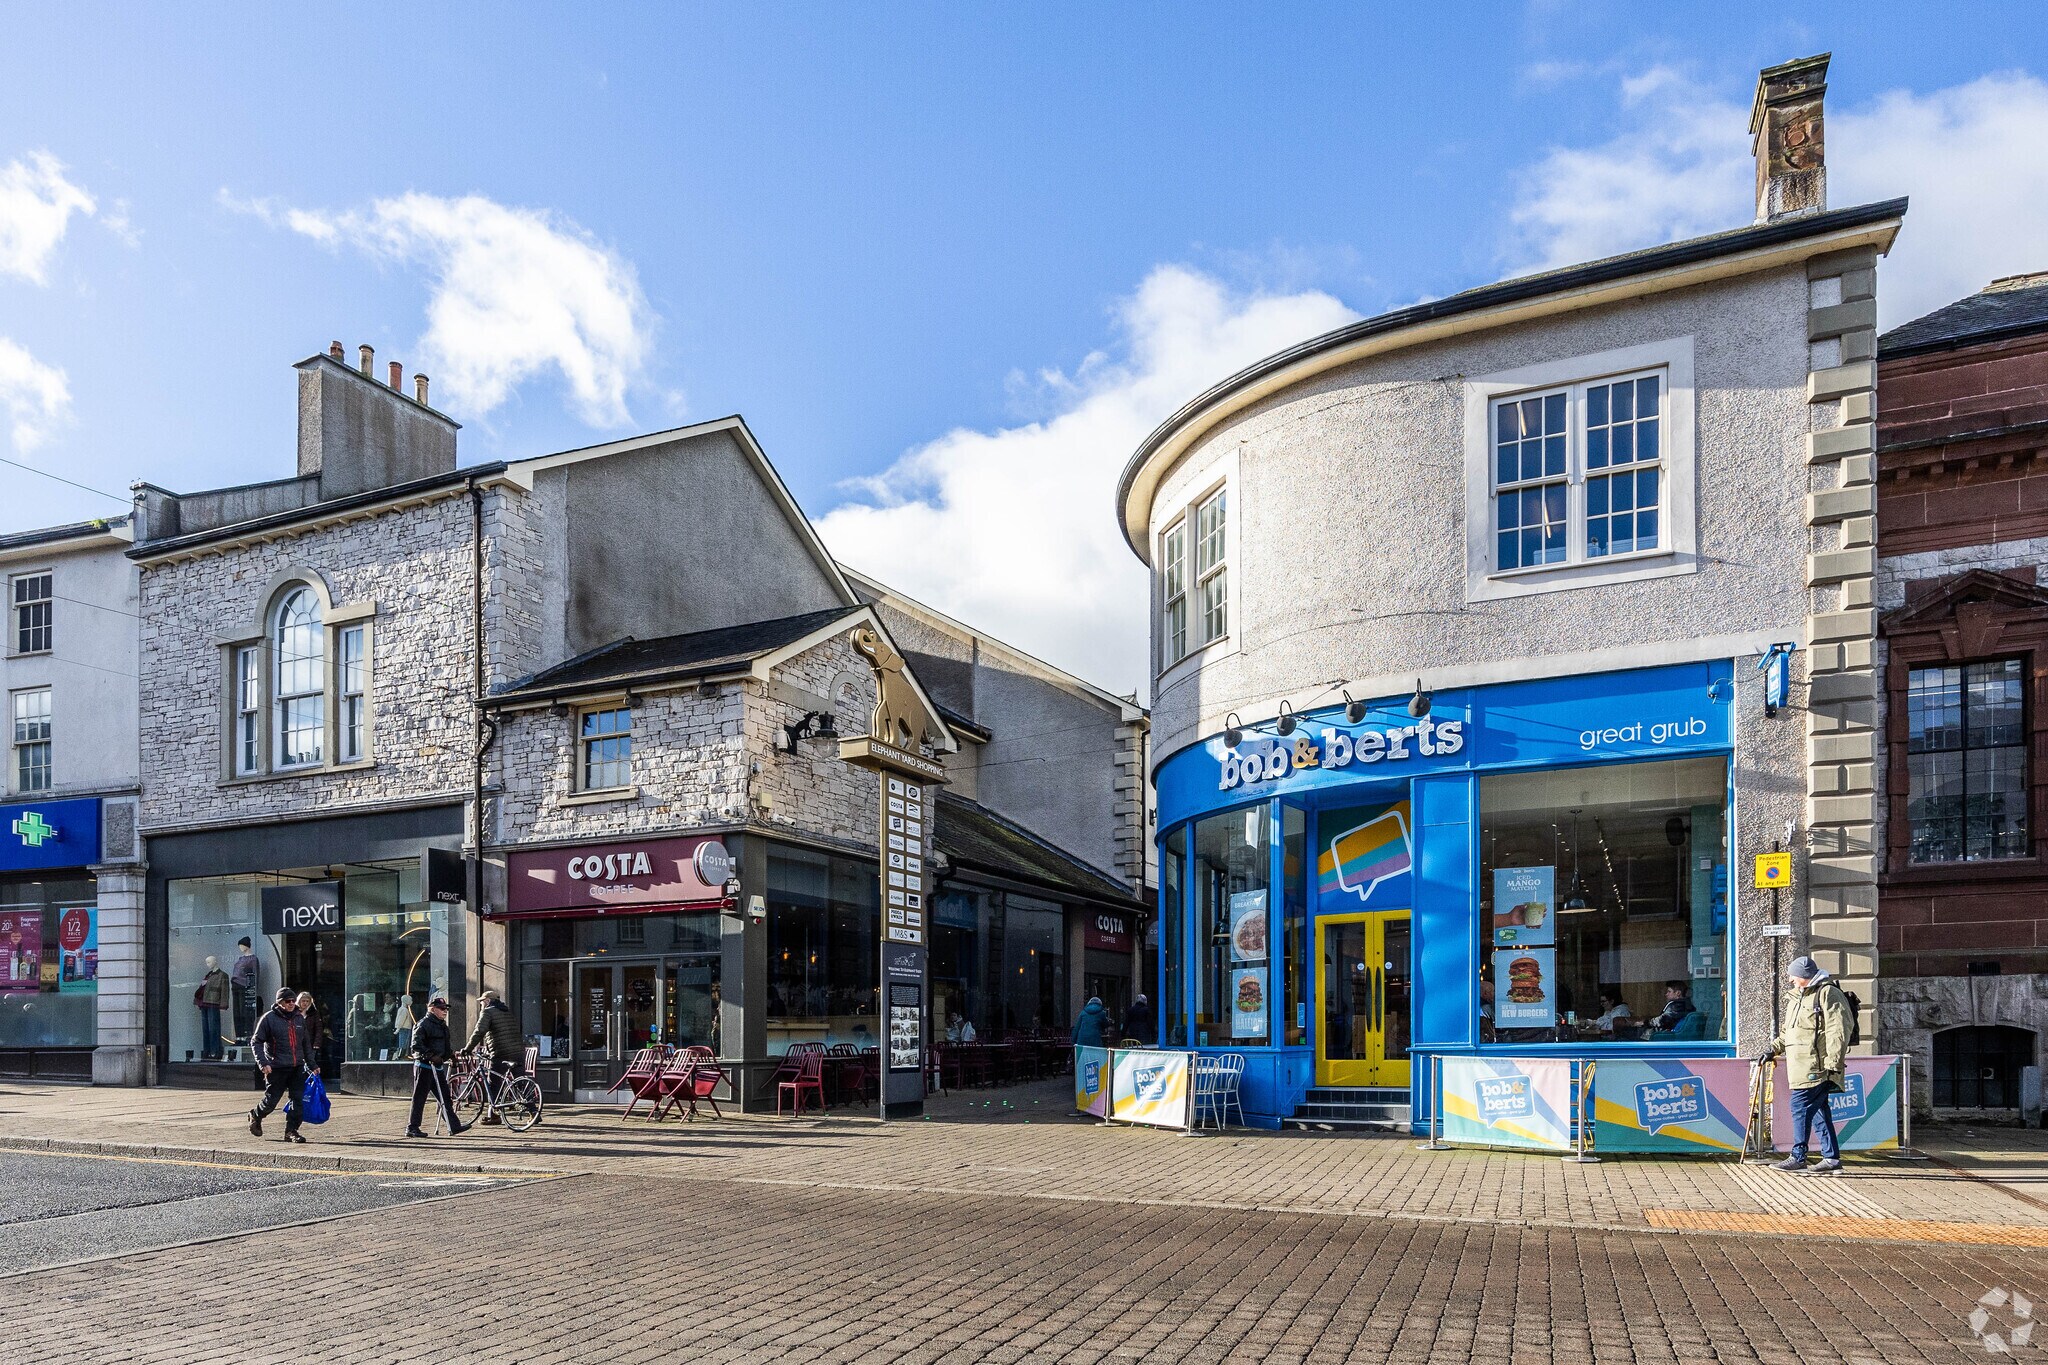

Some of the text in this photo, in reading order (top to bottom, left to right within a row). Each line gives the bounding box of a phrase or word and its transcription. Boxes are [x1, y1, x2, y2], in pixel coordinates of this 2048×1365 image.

[1579, 716, 1707, 750] great grub
[871, 742, 943, 777] ELEPHANT YARD SHOPPING
[890, 801, 903, 809] COSTA
[567, 851, 652, 880] COSTA
[704, 855, 728, 867] COSTA
[1507, 879, 1541, 887] MANGO
[589, 883, 635, 896] COFFEE
[437, 891, 460, 902] next
[282, 903, 336, 928] next
[68, 922, 80, 931] 1/2
[1097, 914, 1124, 934] COSTA
[894, 928, 908, 940] M&S
[1100, 935, 1116, 944] COFFEE
[1502, 1009, 1548, 1018] NEW BURGERS
[1483, 1095, 1526, 1111] berts
[1646, 1098, 1698, 1117] berts
